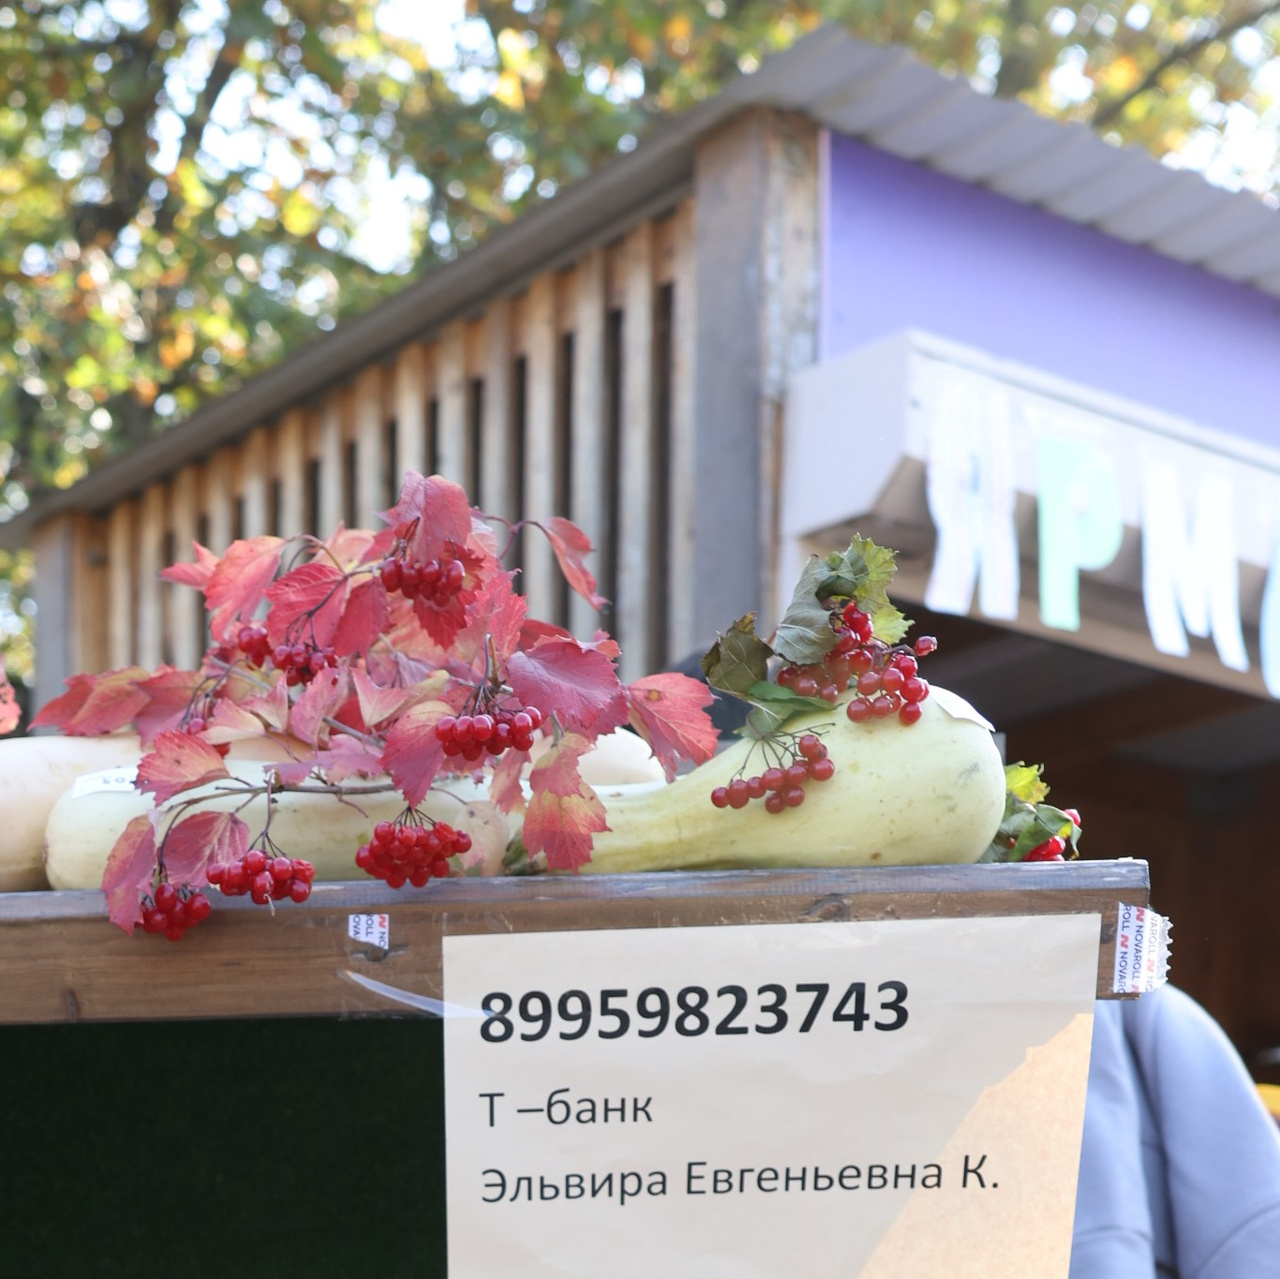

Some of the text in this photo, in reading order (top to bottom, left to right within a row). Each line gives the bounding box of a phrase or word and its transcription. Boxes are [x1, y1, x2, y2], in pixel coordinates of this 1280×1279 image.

[1133, 925, 1143, 981] NOVAROLL
[480, 980, 910, 1043] 89959823743
[479, 1092, 505, 1127] Т
[481, 1154, 999, 1205] Эльвира Евгеньевна К.
